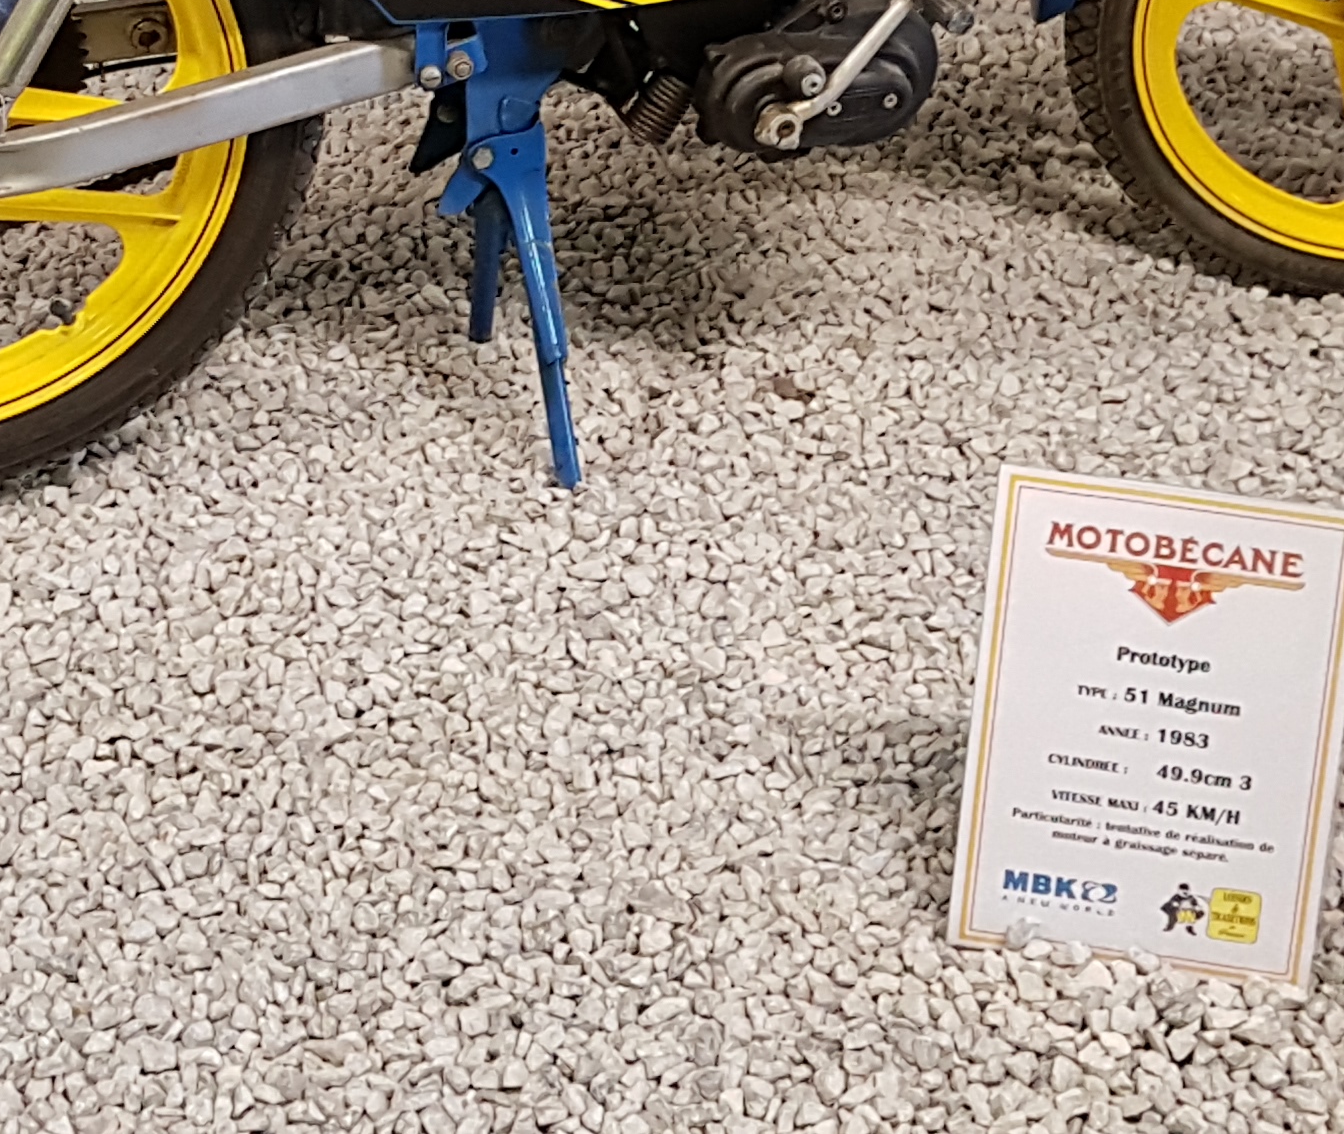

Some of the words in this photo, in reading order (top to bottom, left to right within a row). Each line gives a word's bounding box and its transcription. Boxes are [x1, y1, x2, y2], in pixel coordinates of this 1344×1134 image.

[1047, 521, 1305, 578] MOTOBÉCANE
[1116, 646, 1212, 674] Prototype
[1123, 687, 1149, 704] 51
[1158, 692, 1242, 716] Magnum
[1157, 729, 1210, 749] 1983
[1156, 764, 1232, 789] 49.9cm
[1239, 775, 1253, 791] 3
[1051, 789, 1103, 807] VITESSE
[1152, 800, 1179, 817] 45
[1186, 804, 1241, 826] KM/H
[1165, 829, 1181, 841] de
[1259, 842, 1275, 854] de
[1003, 869, 1077, 900] MBK
